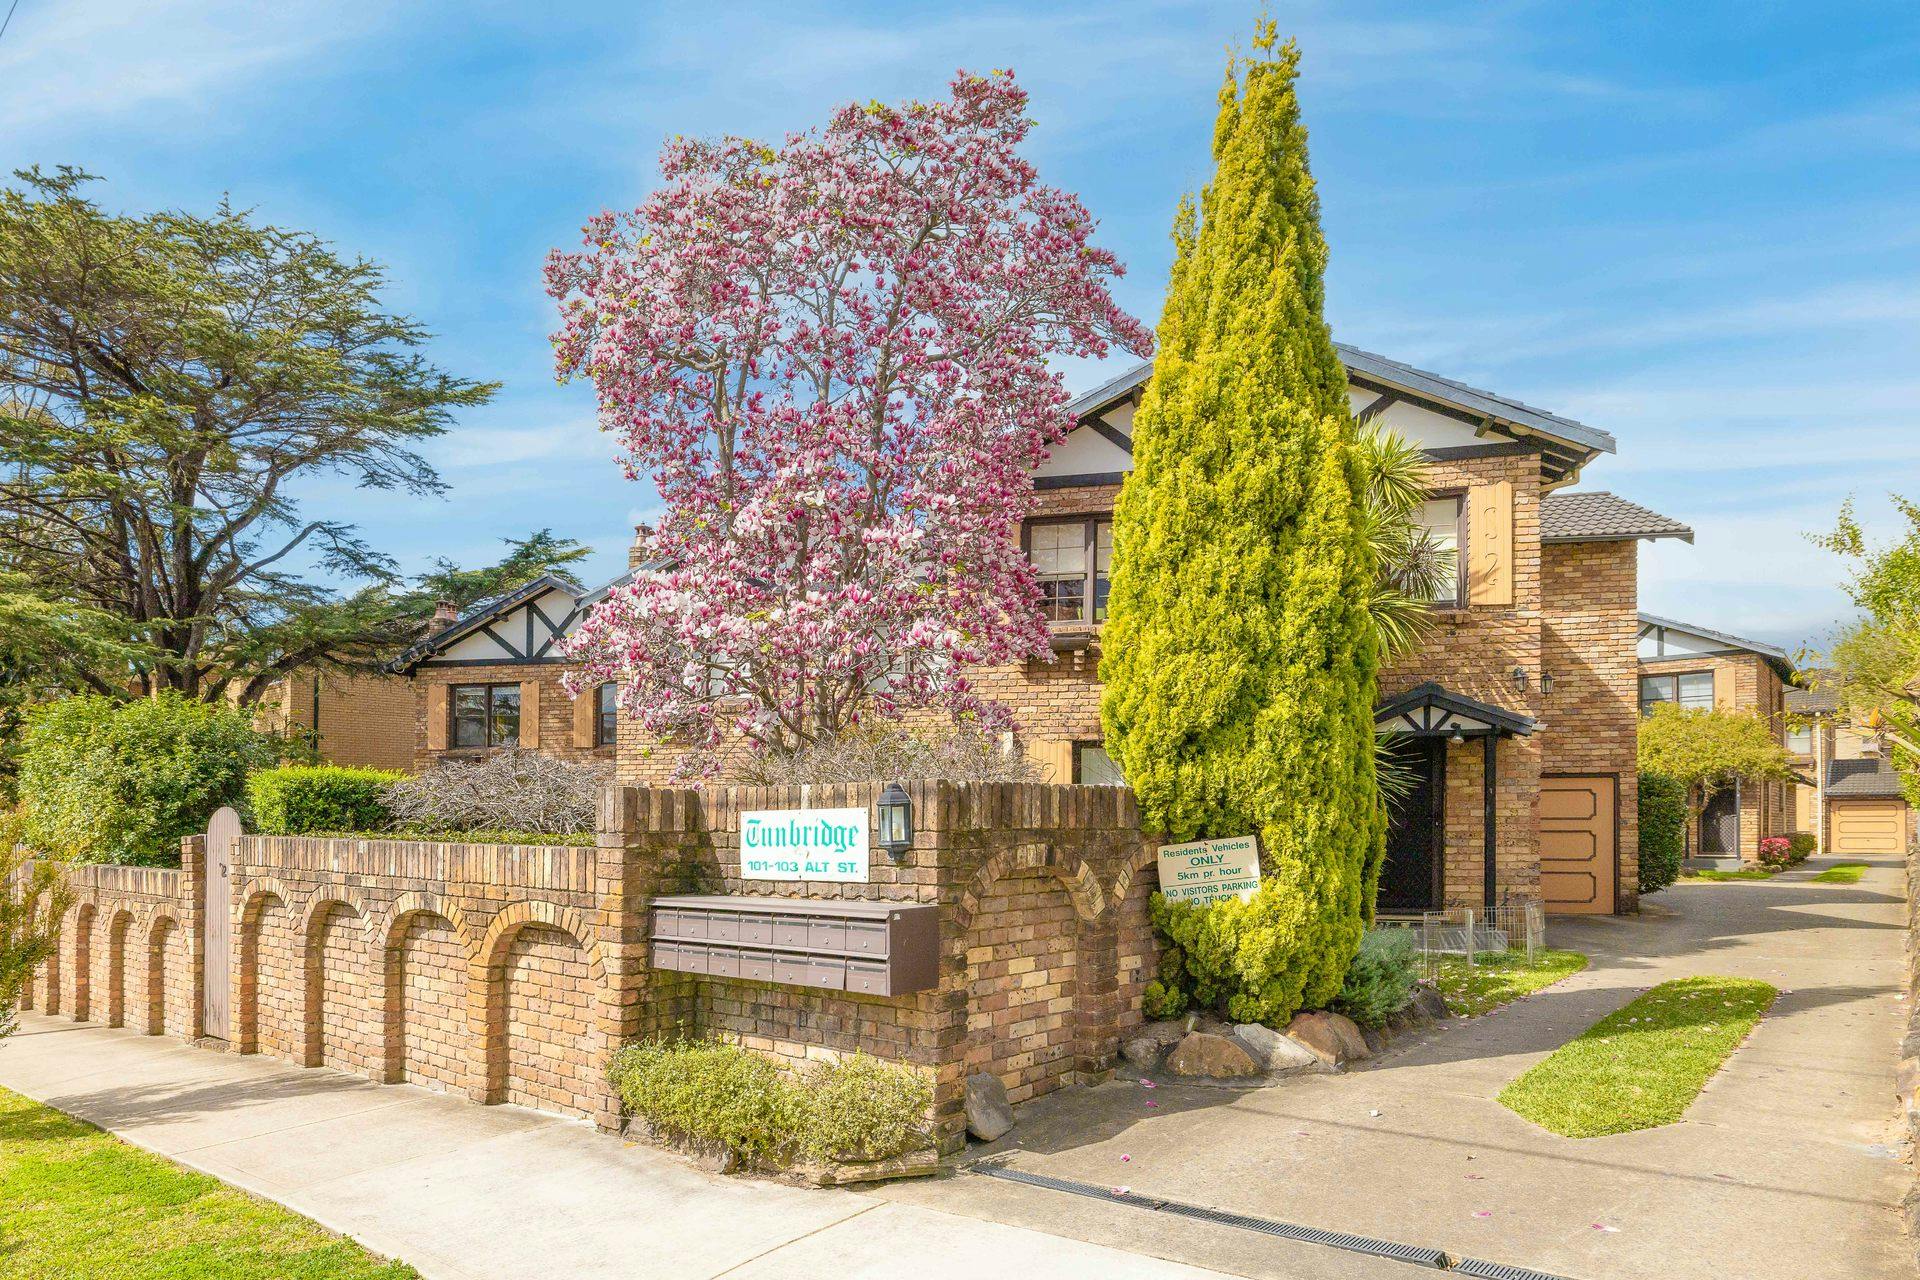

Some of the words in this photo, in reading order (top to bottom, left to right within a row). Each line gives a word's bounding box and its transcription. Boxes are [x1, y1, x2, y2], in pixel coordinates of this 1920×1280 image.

[746, 817, 859, 853] Tunbridge
[1163, 846, 1208, 858] Residents
[1212, 841, 1250, 853] Vehicles
[747, 860, 799, 872] 101-103
[805, 861, 830, 873] ALT
[837, 862, 858, 873] ST.
[1190, 854, 1225, 866] ONLY
[1177, 871, 1199, 881] 5km
[1203, 871, 1215, 879] pr.
[1219, 867, 1242, 876] hour
[1165, 889, 1178, 898] NO
[1182, 884, 1219, 896] VISITORS
[1222, 880, 1258, 891] PARKING
